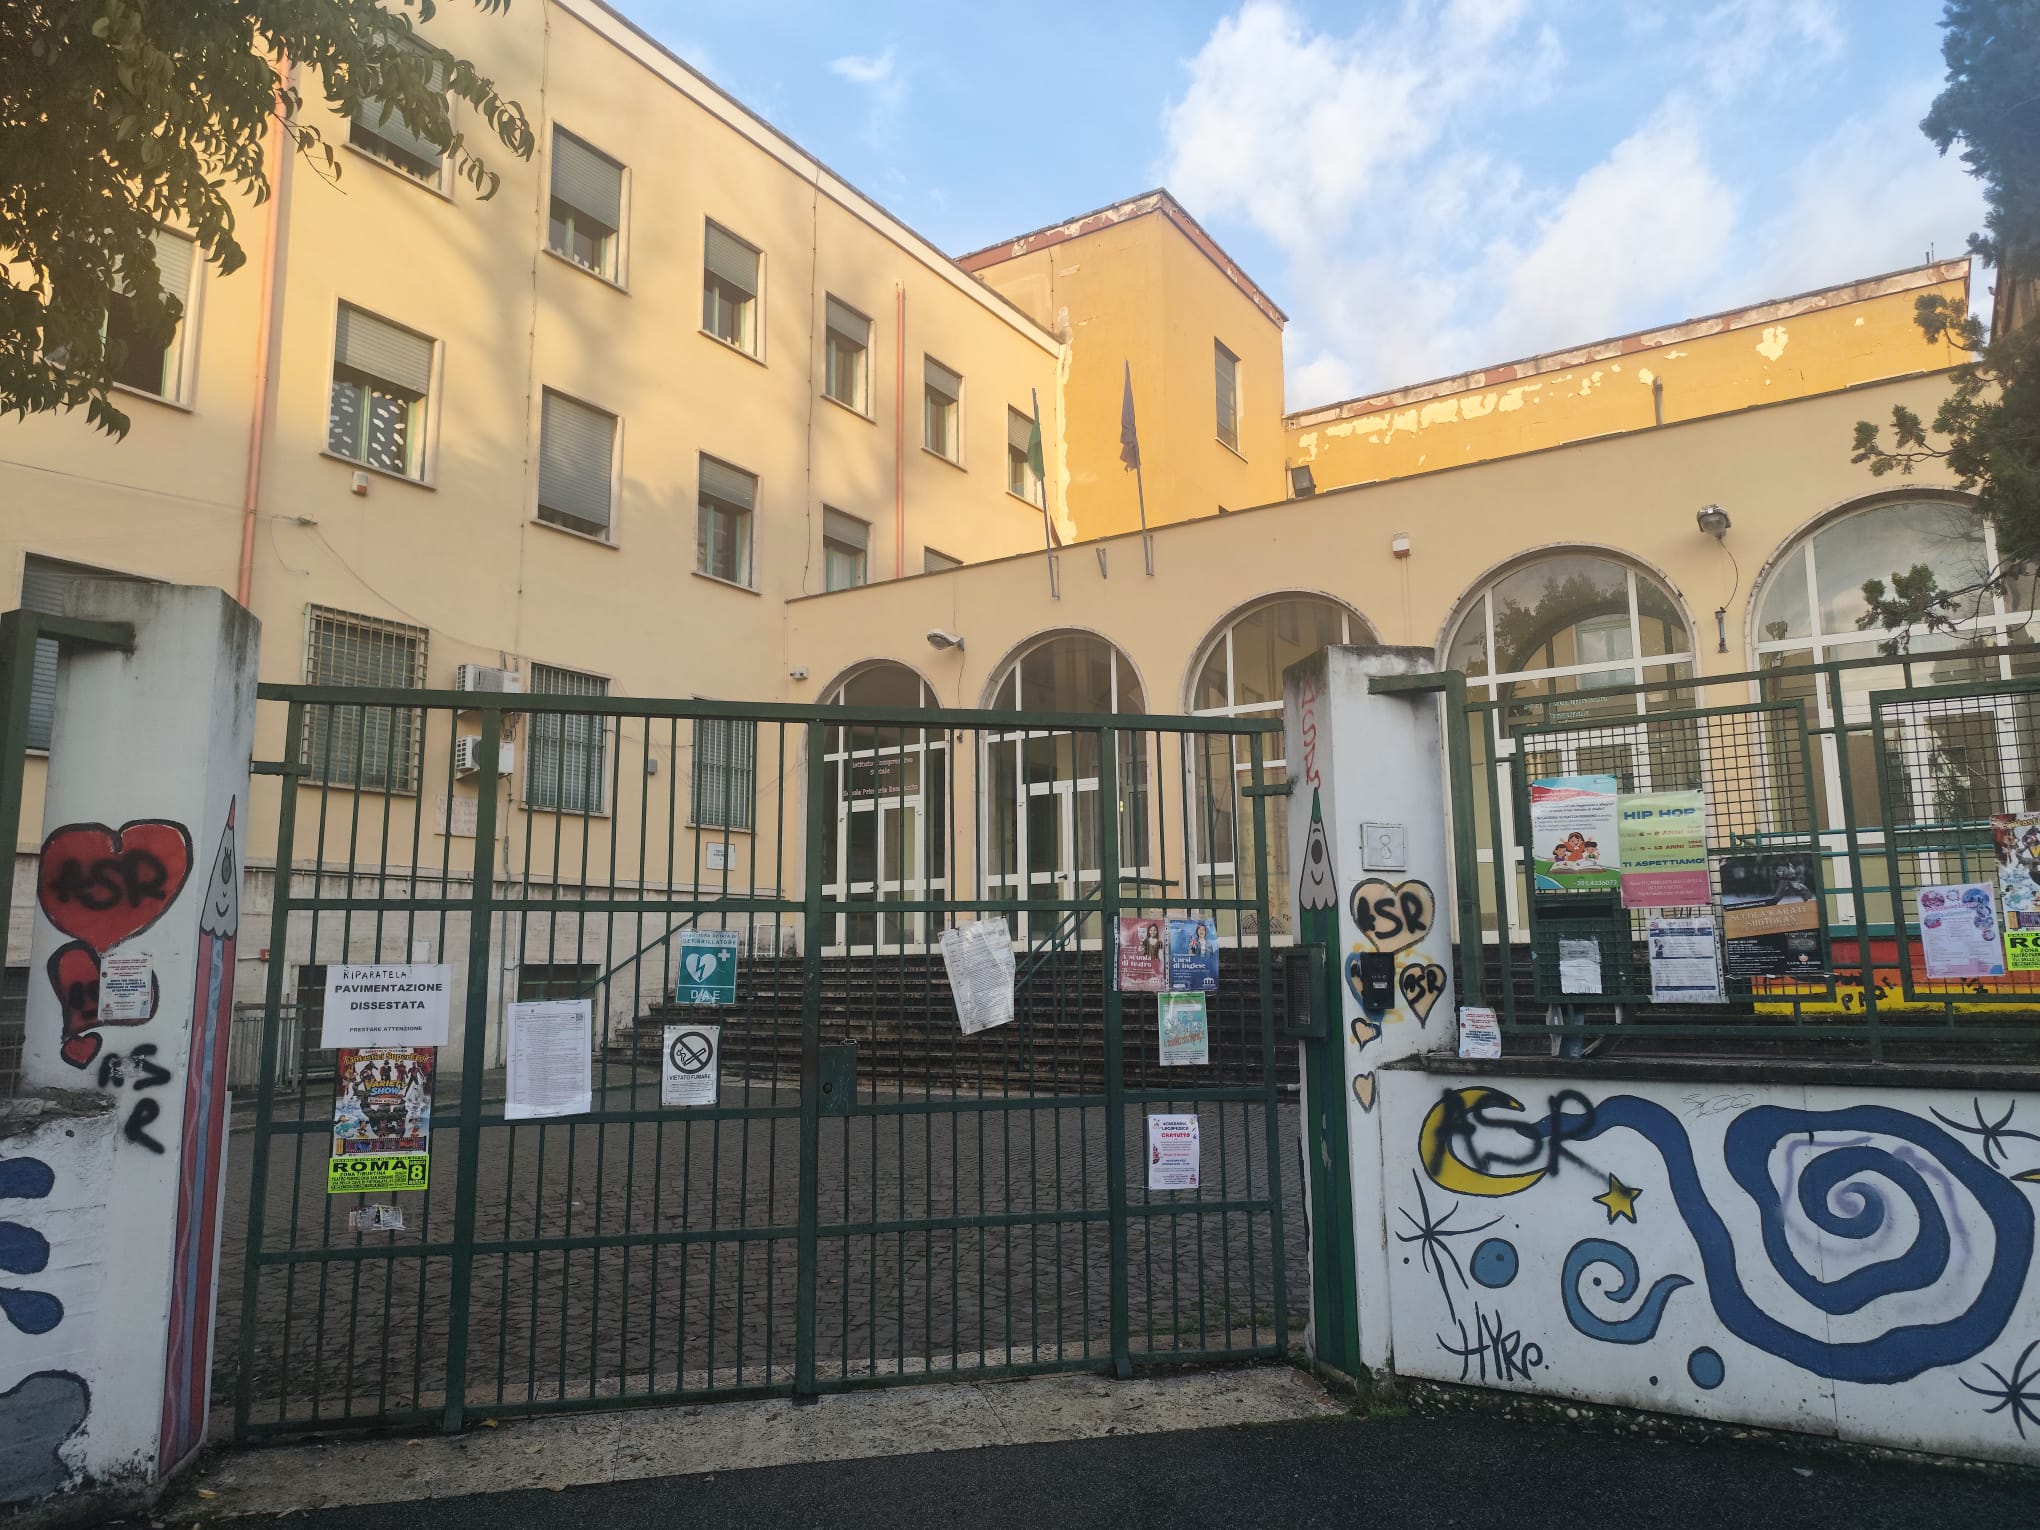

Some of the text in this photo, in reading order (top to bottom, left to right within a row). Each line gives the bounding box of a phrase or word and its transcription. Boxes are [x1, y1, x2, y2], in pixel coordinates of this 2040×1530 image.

[1623, 808, 1695, 820] HIP HOP
[1378, 834, 1392, 860] 8
[1636, 858, 1705, 867] ASPETTIAMO!
[335, 983, 443, 993] PAVIMENTAZIONE
[350, 1001, 425, 1010] DISSESTATA
[333, 1160, 408, 1173] ROMA
[410, 1164, 423, 1180] 8
